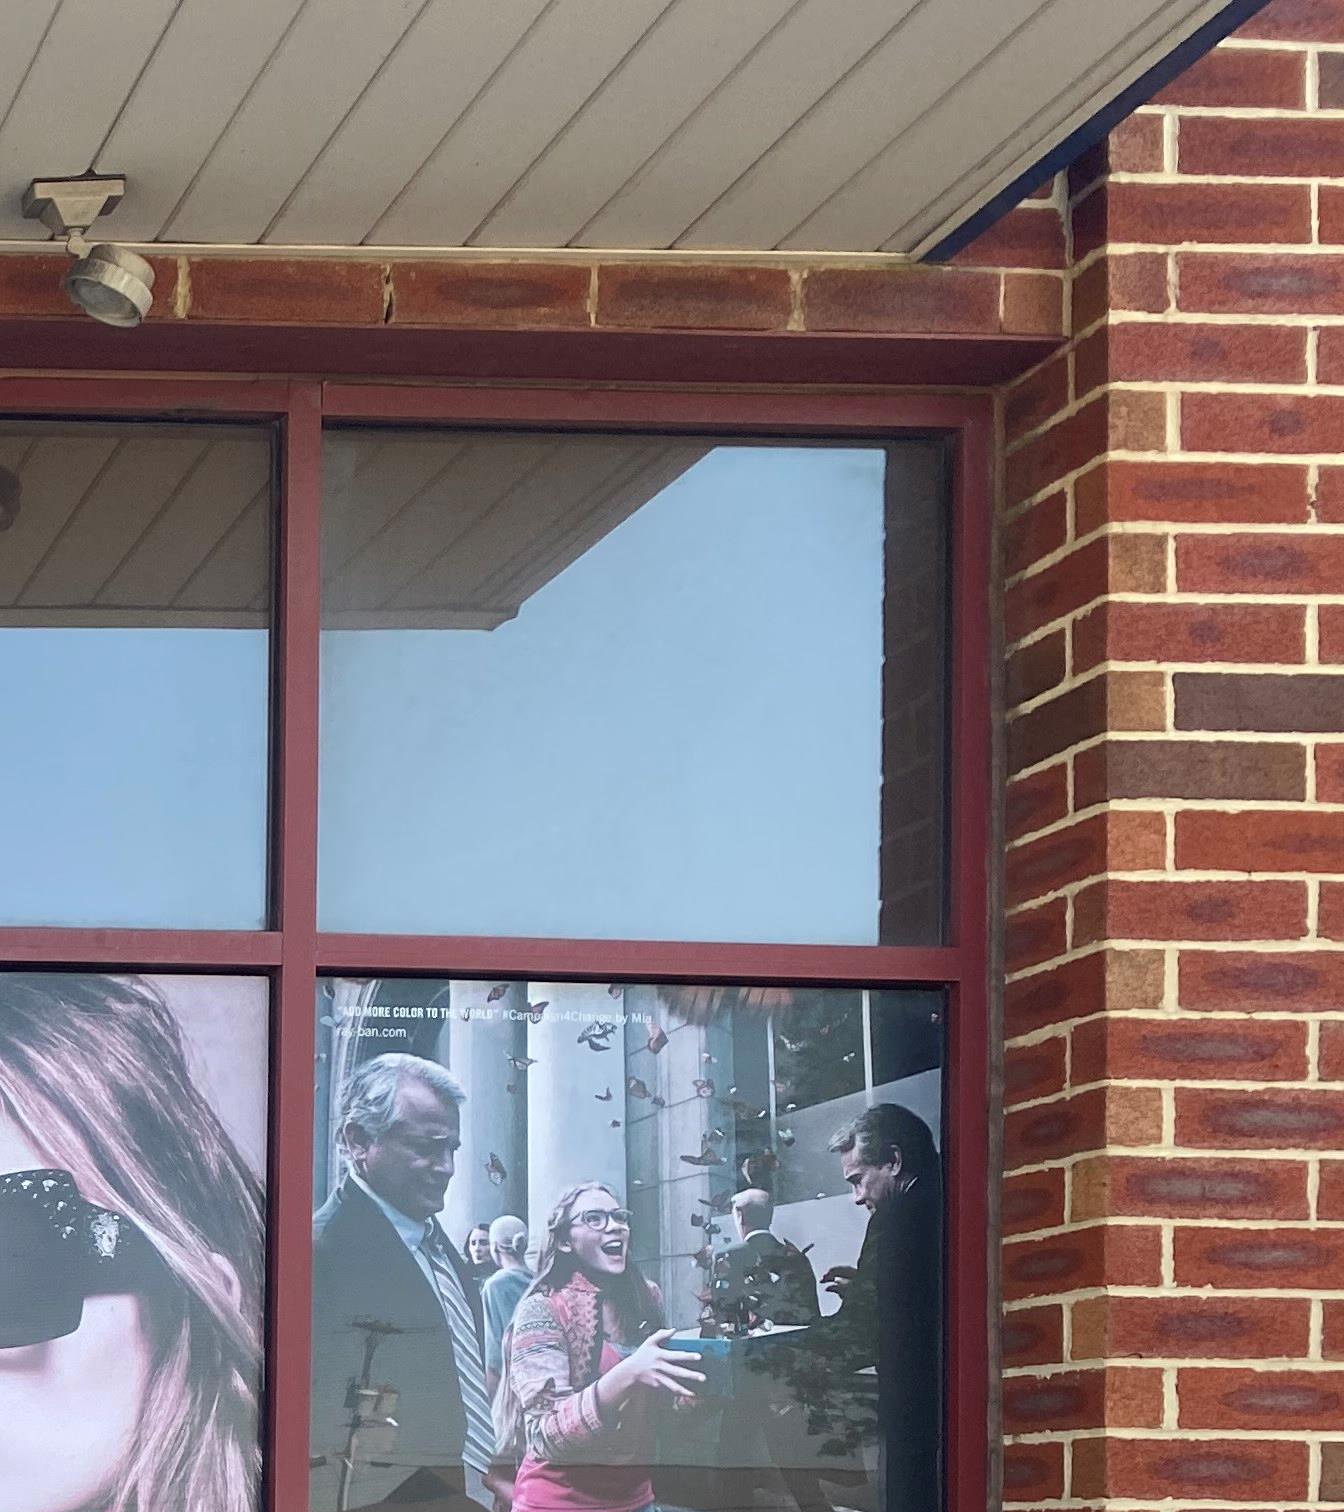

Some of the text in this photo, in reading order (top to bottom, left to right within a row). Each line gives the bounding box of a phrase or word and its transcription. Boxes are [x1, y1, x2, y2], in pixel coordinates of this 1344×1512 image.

[364, 1006, 391, 1018] MORE
[393, 1007, 424, 1019] COLOR
[425, 1008, 438, 1019] TO
[615, 1011, 628, 1025] by
